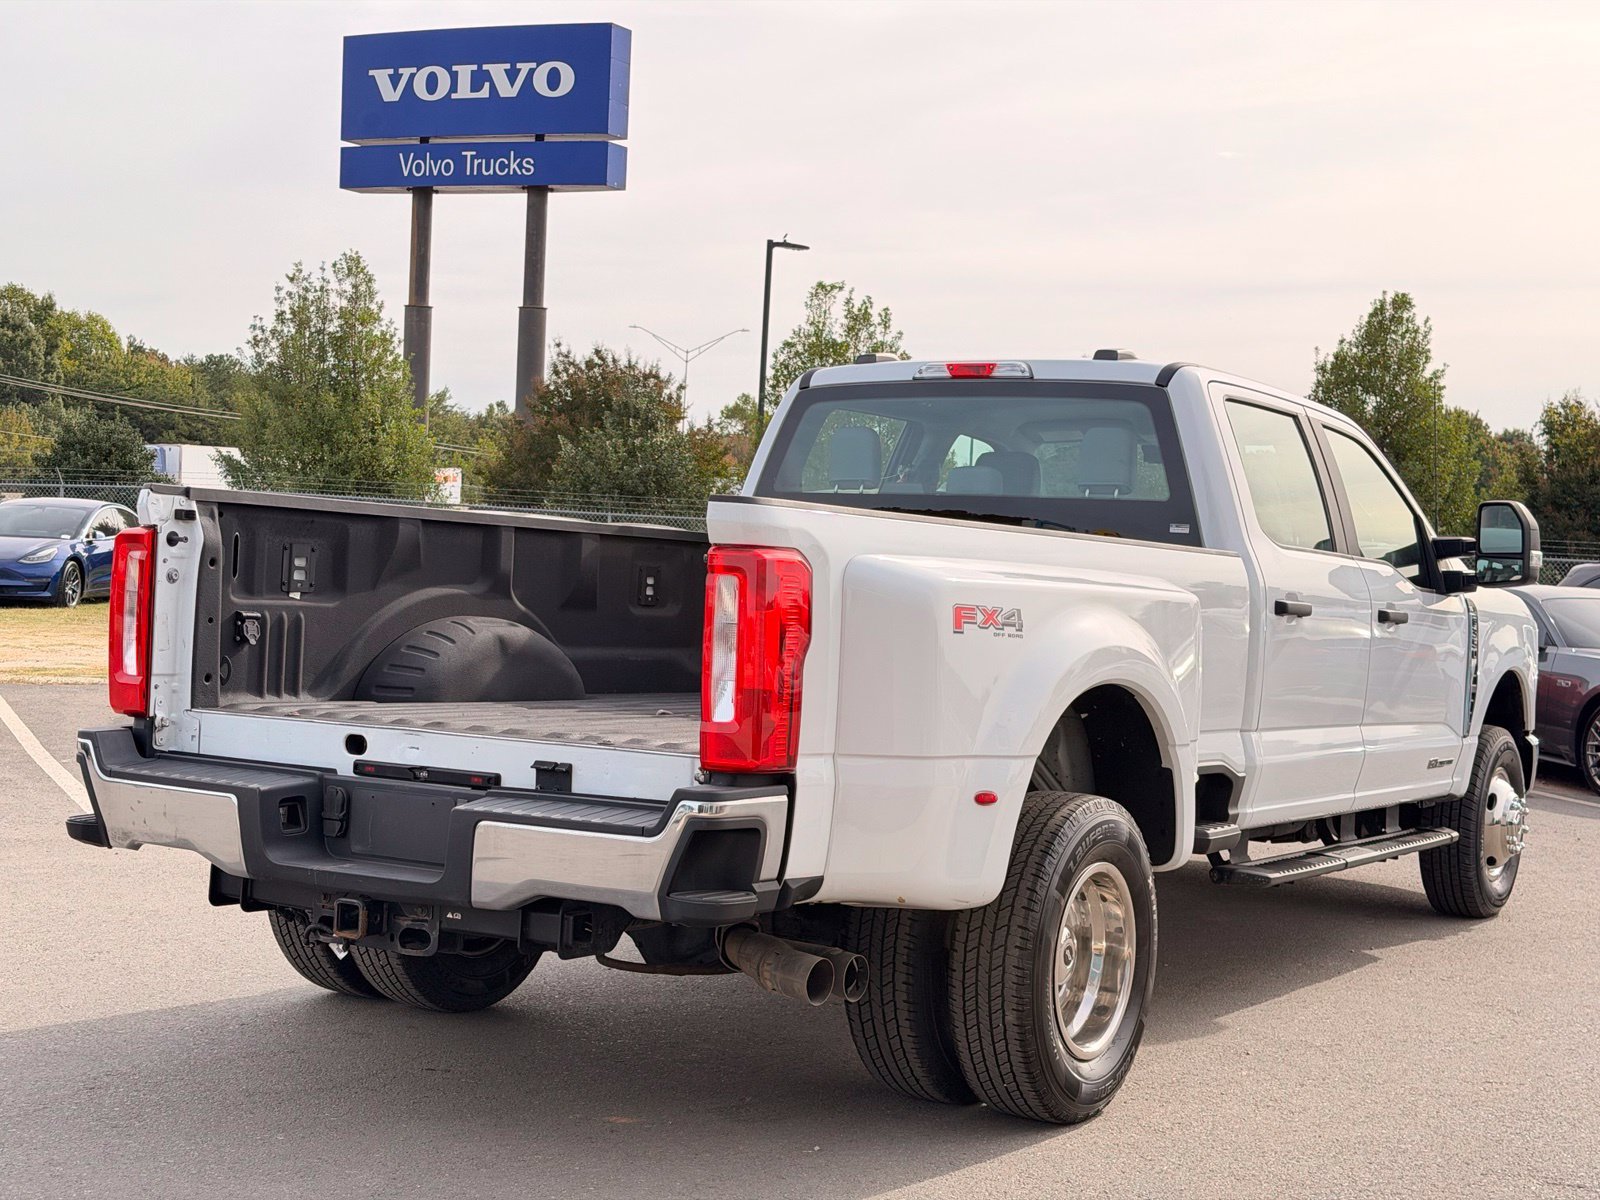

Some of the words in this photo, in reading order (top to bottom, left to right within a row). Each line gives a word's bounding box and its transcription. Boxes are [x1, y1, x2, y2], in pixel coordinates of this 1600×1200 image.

[368, 61, 575, 102] VOLVO
[399, 152, 454, 177] Volvo
[461, 150, 535, 176] Trucks
[952, 603, 1024, 634] FX4
